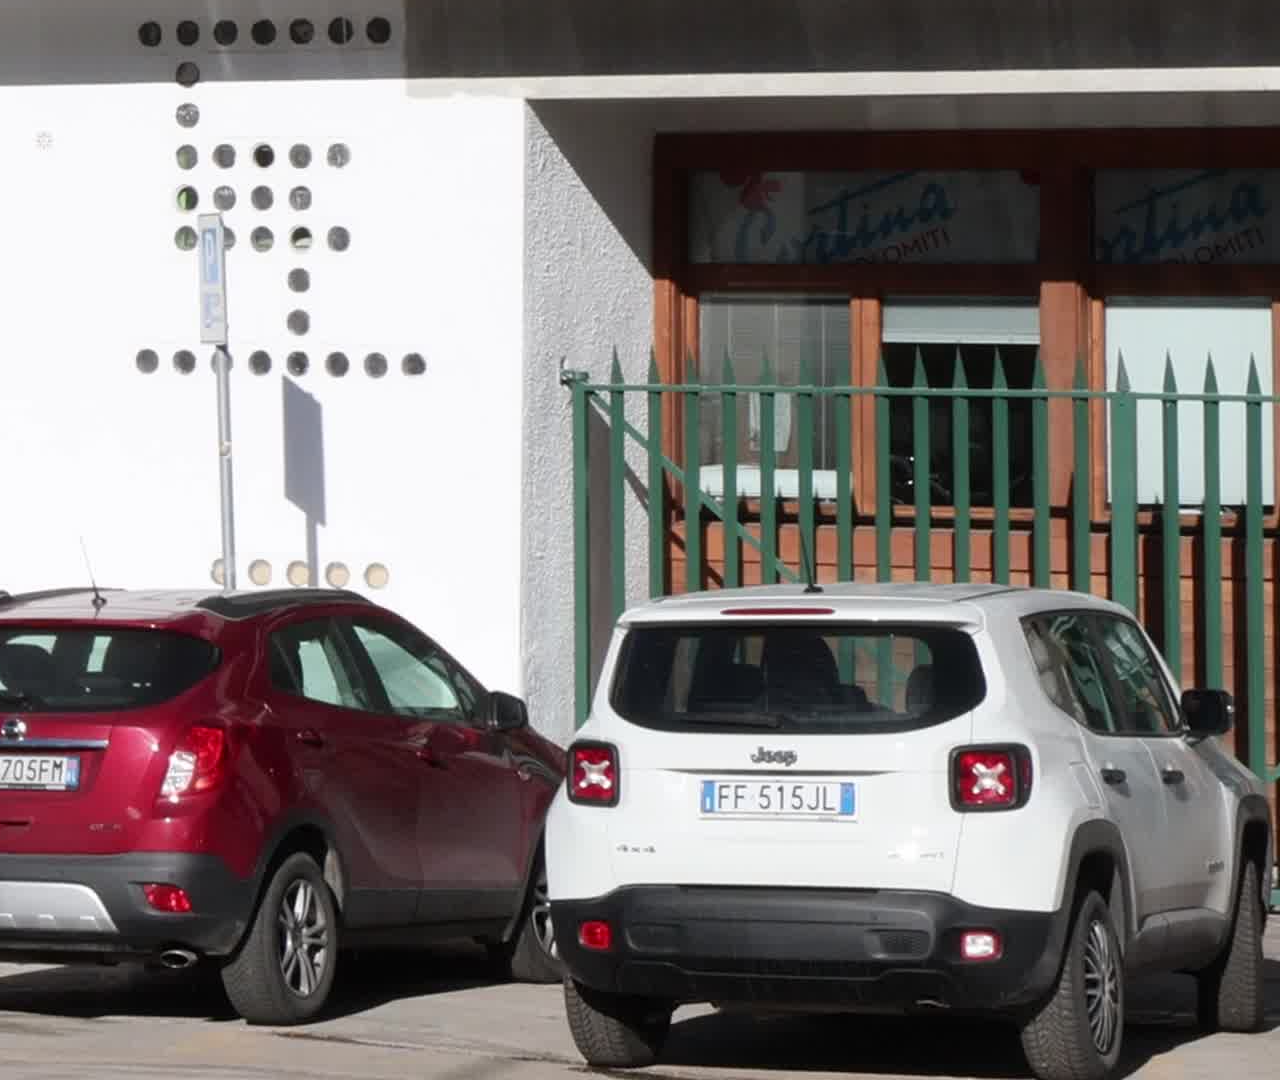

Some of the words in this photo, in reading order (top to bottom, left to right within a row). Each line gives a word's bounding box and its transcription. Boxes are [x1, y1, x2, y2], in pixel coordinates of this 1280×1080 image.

[750, 746, 798, 767] Jeep
[0, 759, 64, 782] 705FM
[717, 784, 748, 810] FF
[758, 785, 837, 812] 515JL
